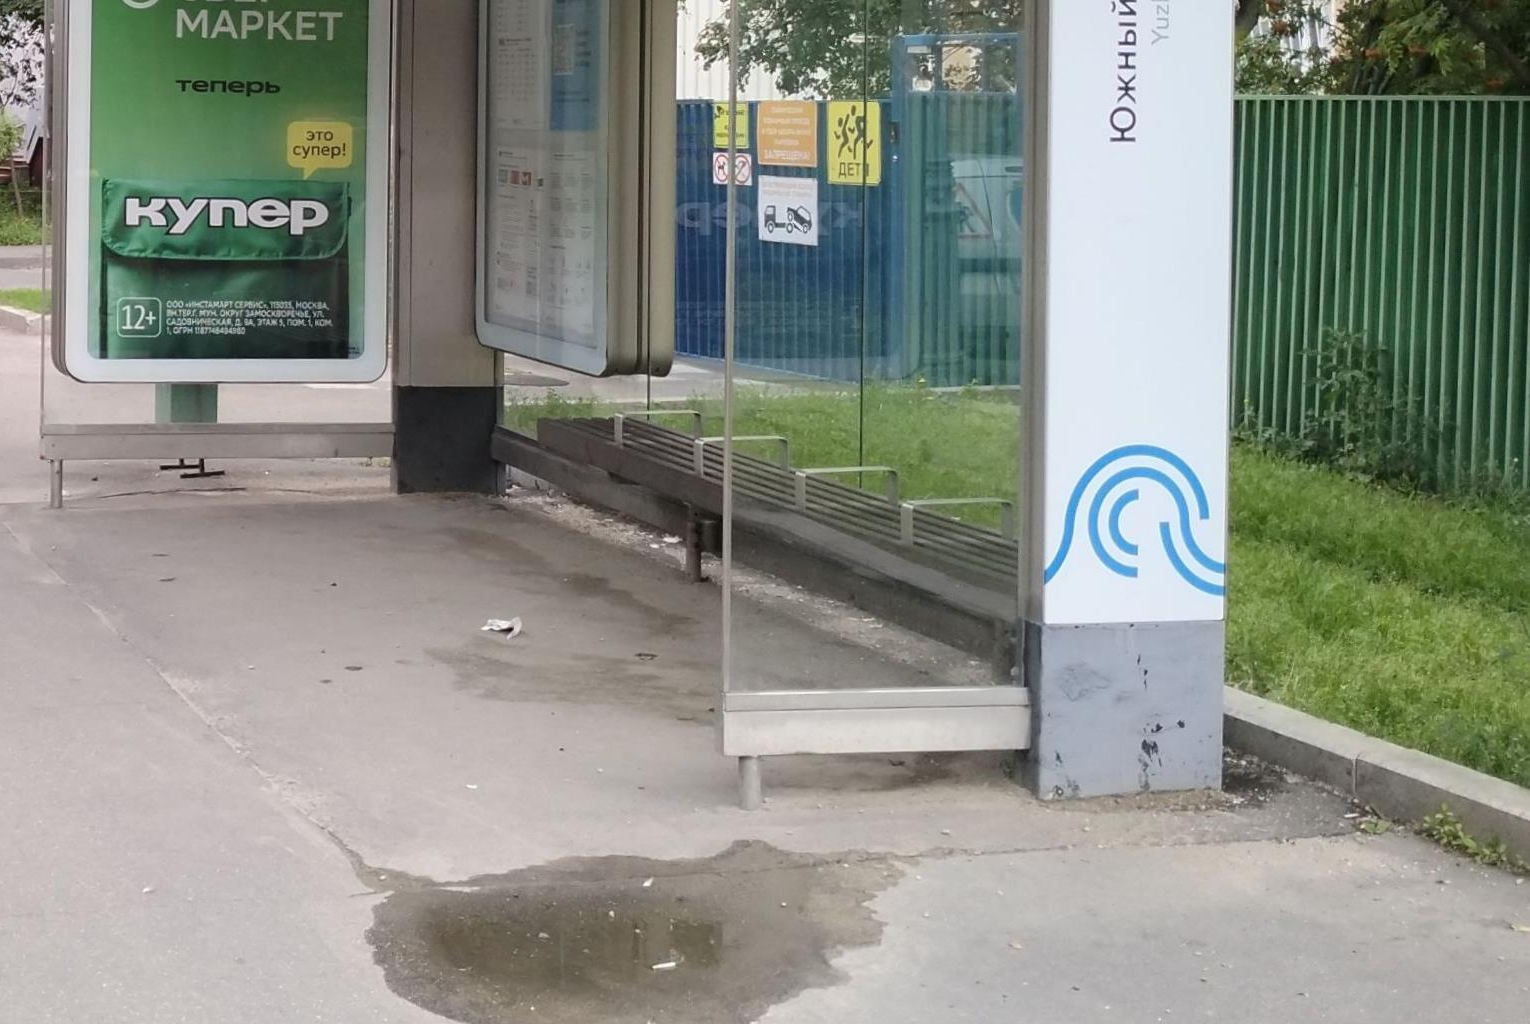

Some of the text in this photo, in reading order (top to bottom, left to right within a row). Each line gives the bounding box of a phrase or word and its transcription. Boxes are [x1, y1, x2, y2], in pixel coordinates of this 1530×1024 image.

[175, 9, 343, 41] МАРКЕТ
[175, 79, 281, 97] теперь
[305, 130, 334, 142] это
[292, 142, 347, 159] супер!
[125, 195, 330, 236] купер
[166, 300, 184, 308] ООО
[121, 304, 157, 330] 12+
